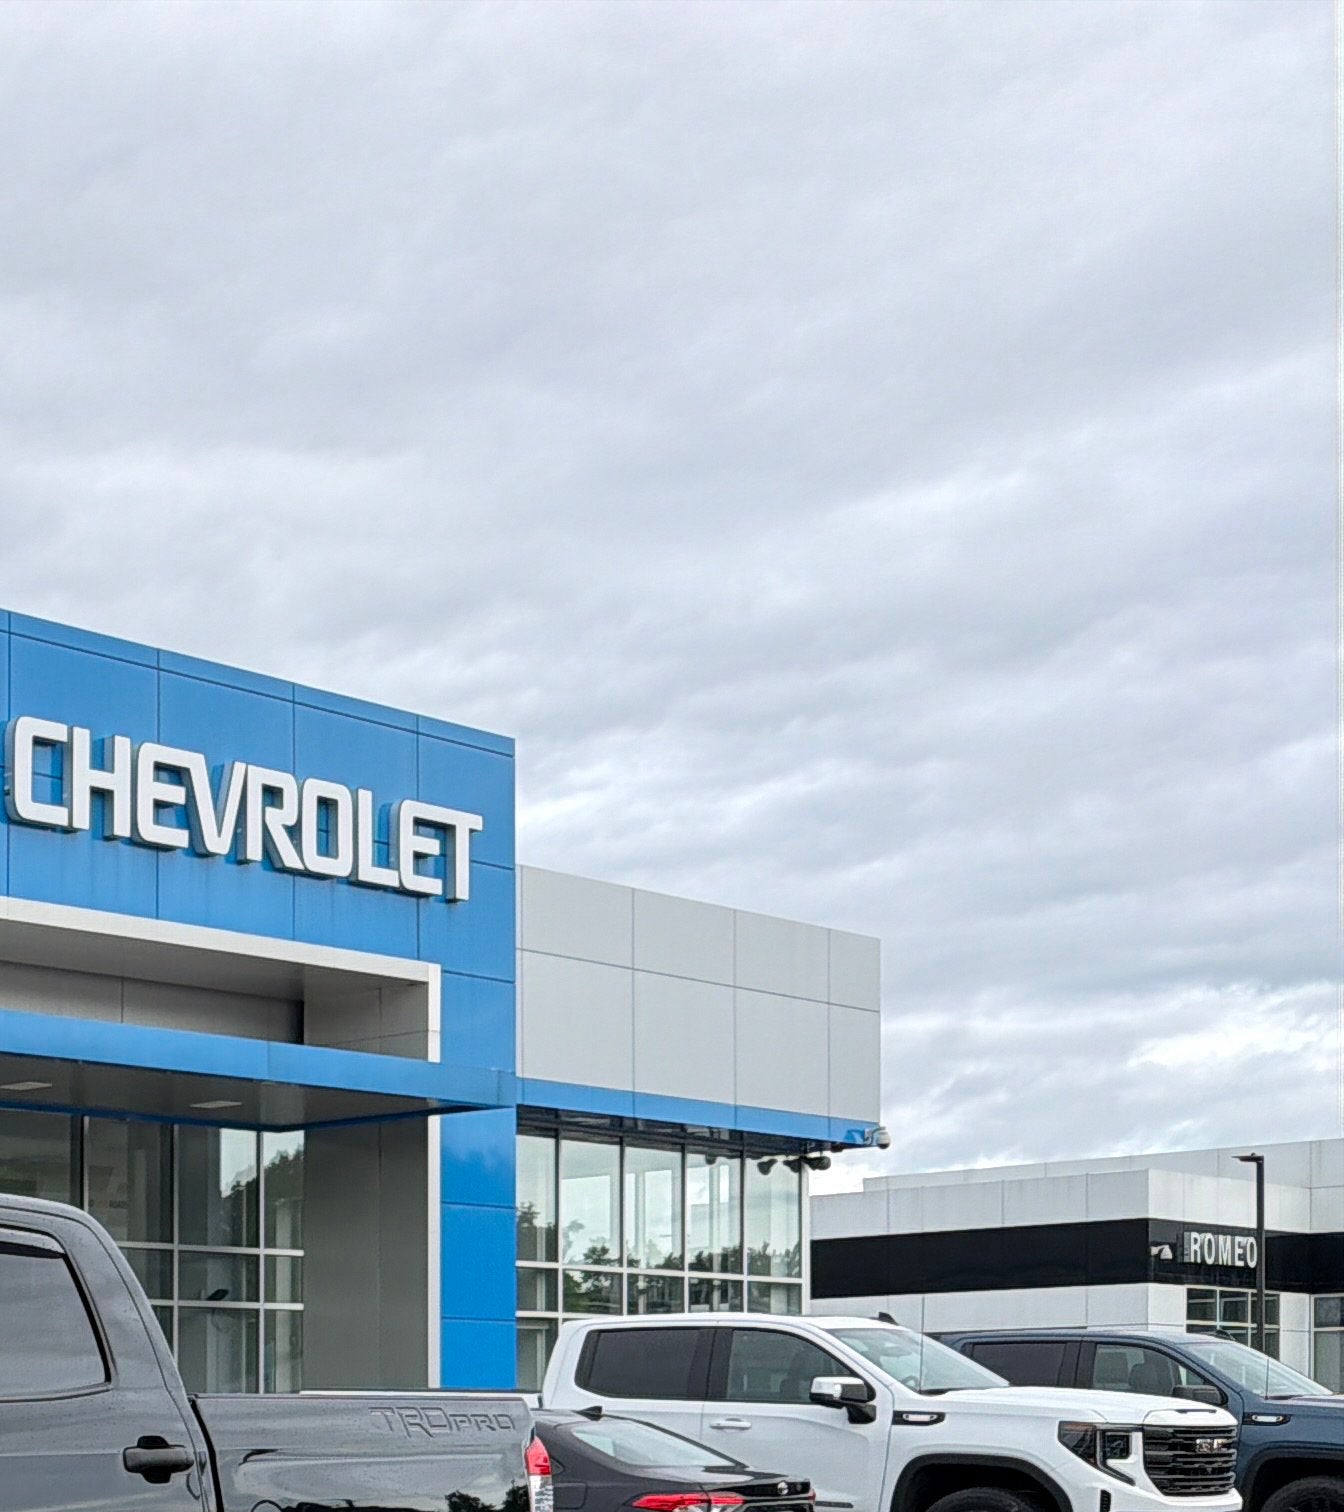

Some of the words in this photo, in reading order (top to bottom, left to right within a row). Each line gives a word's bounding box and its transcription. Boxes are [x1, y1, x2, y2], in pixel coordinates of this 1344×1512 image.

[7, 716, 483, 901] CHEVROLET
[1188, 1231, 1258, 1268] ROMEO
[368, 1407, 453, 1438] TRD
[449, 1414, 516, 1431] PRO
